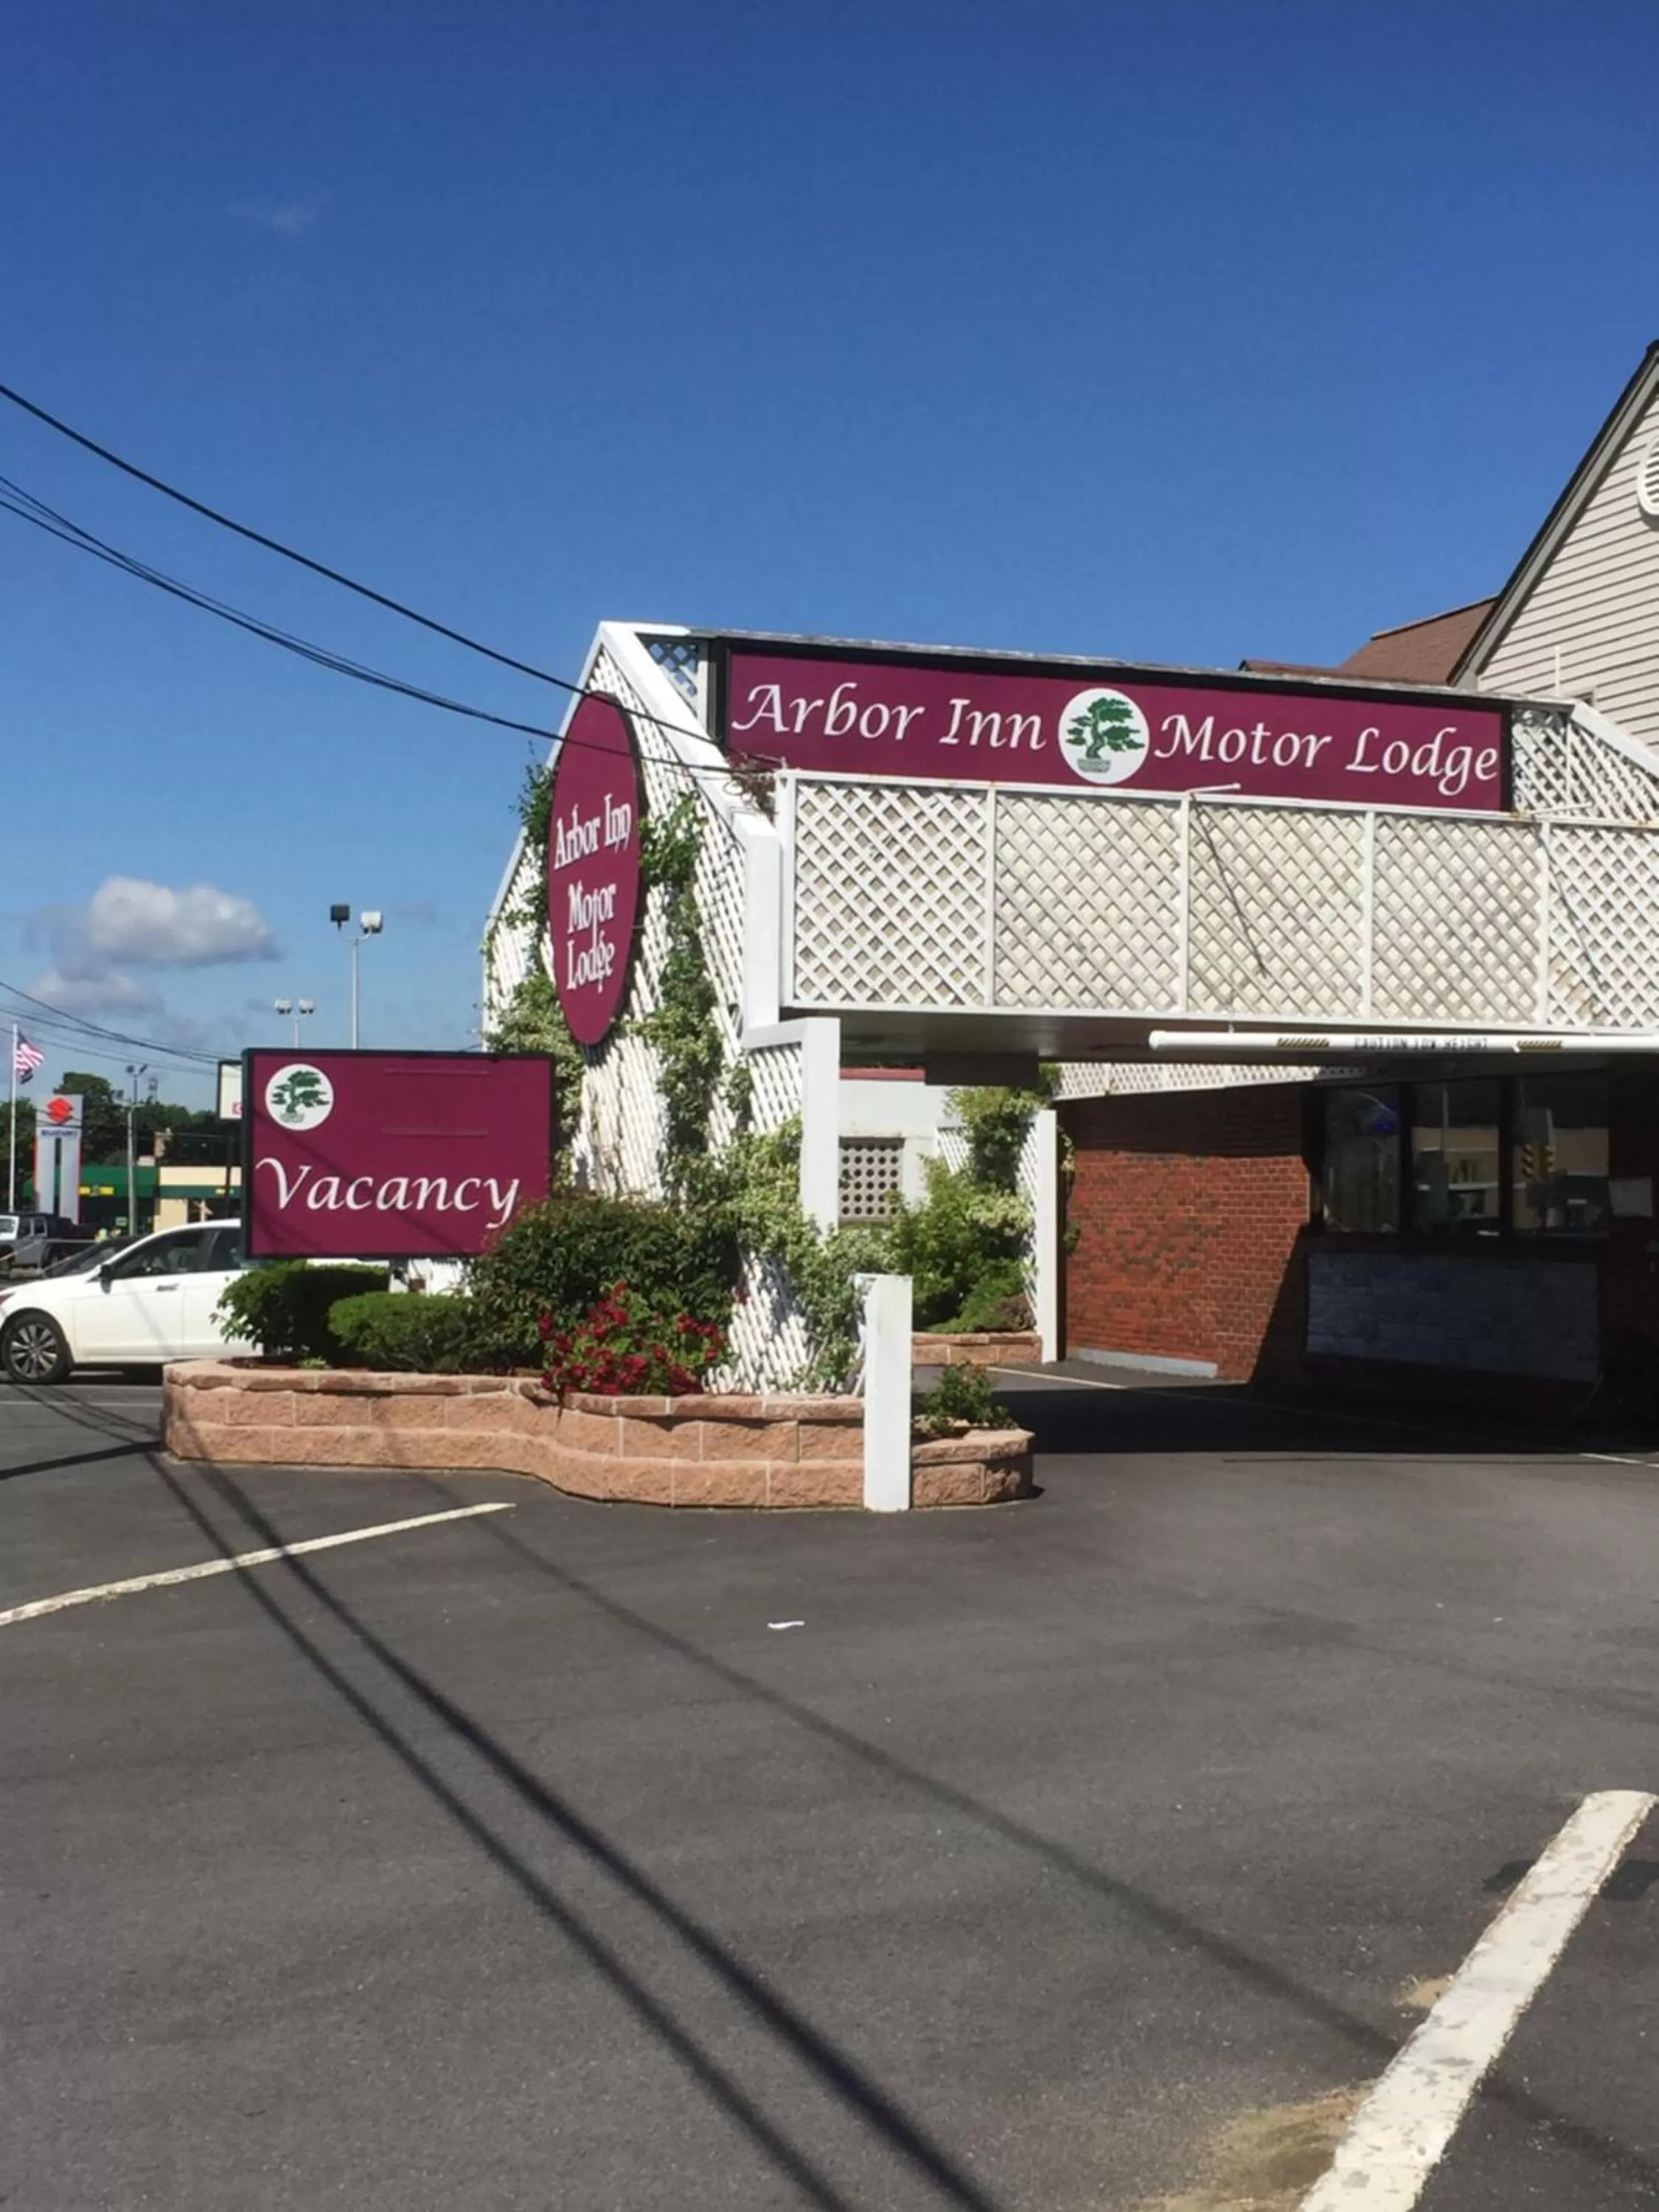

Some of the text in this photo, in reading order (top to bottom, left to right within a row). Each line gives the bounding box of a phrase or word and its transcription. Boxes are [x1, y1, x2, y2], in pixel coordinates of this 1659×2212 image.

[731, 682, 1499, 796] Arbor Inn Motor Lodge
[554, 793, 632, 869] Arbor Inn
[567, 880, 616, 933] Motor
[566, 926, 616, 994] Lodge
[254, 1157, 520, 1229] Vacancy
